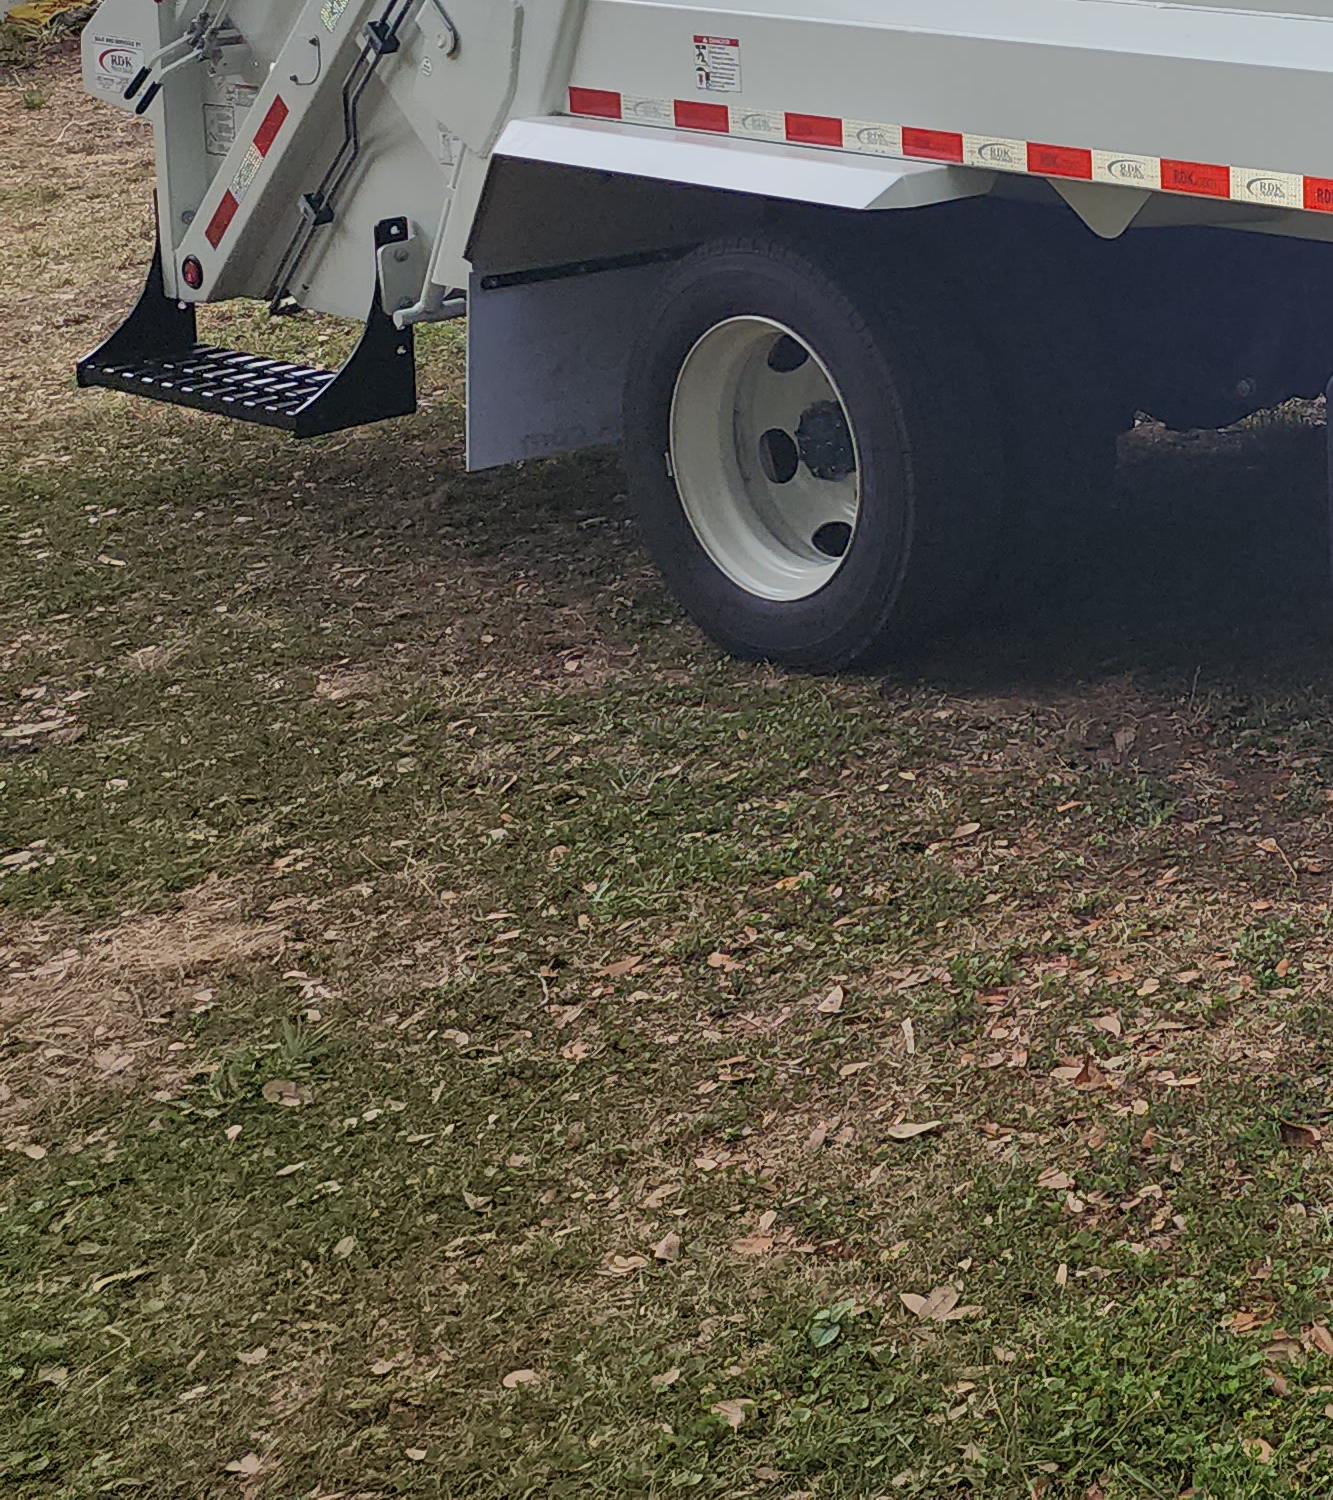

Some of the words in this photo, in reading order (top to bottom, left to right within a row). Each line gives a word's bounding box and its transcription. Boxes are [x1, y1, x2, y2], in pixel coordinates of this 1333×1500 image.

[111, 54, 133, 67] RDK
[1120, 163, 1142, 175] RDK
[1259, 182, 1282, 193] RDK
